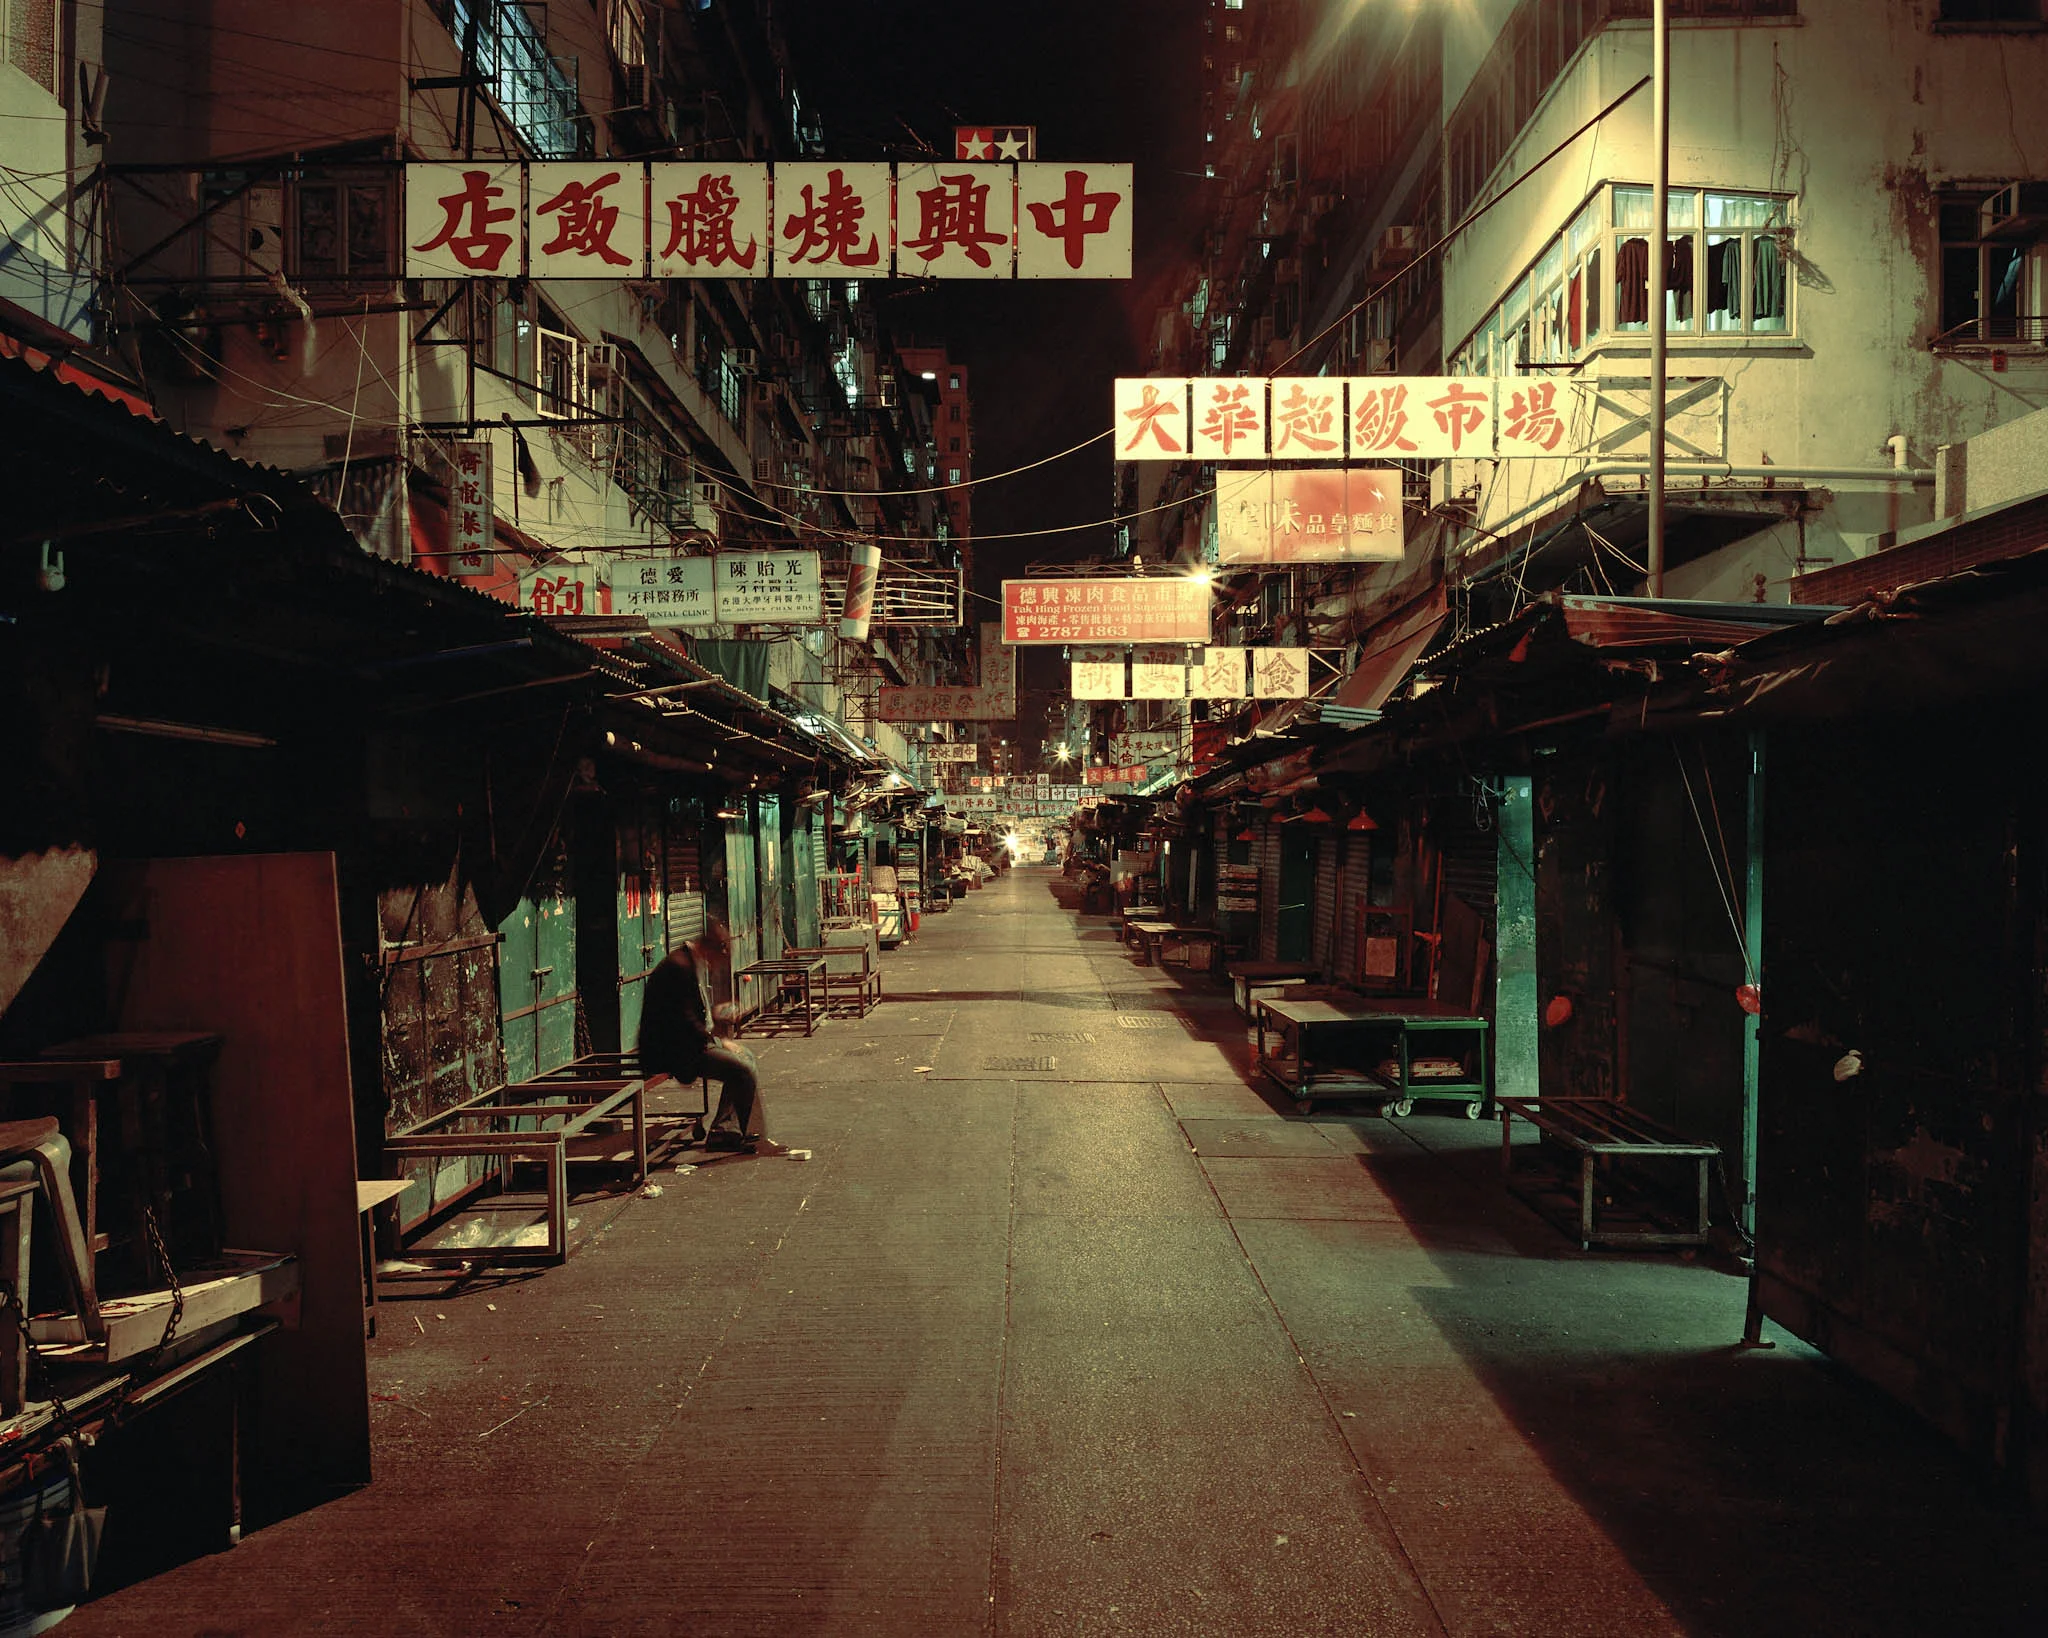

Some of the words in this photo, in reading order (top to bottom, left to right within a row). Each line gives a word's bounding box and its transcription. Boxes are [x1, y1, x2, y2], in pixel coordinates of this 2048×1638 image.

[1124, 382, 1564, 455] 大華超級市場
[640, 566, 684, 585] 德愛
[627, 588, 700, 605] 牙科醫務所
[646, 610, 678, 619] DENTAL
[682, 608, 711, 617] CLINIC
[1013, 604, 1032, 614] Tak
[1035, 604, 1061, 615] Hing
[1063, 604, 1100, 614] Frozen
[1103, 603, 1130, 614] Food
[1039, 626, 1082, 638] 2787
[1088, 625, 1128, 637] 1863
